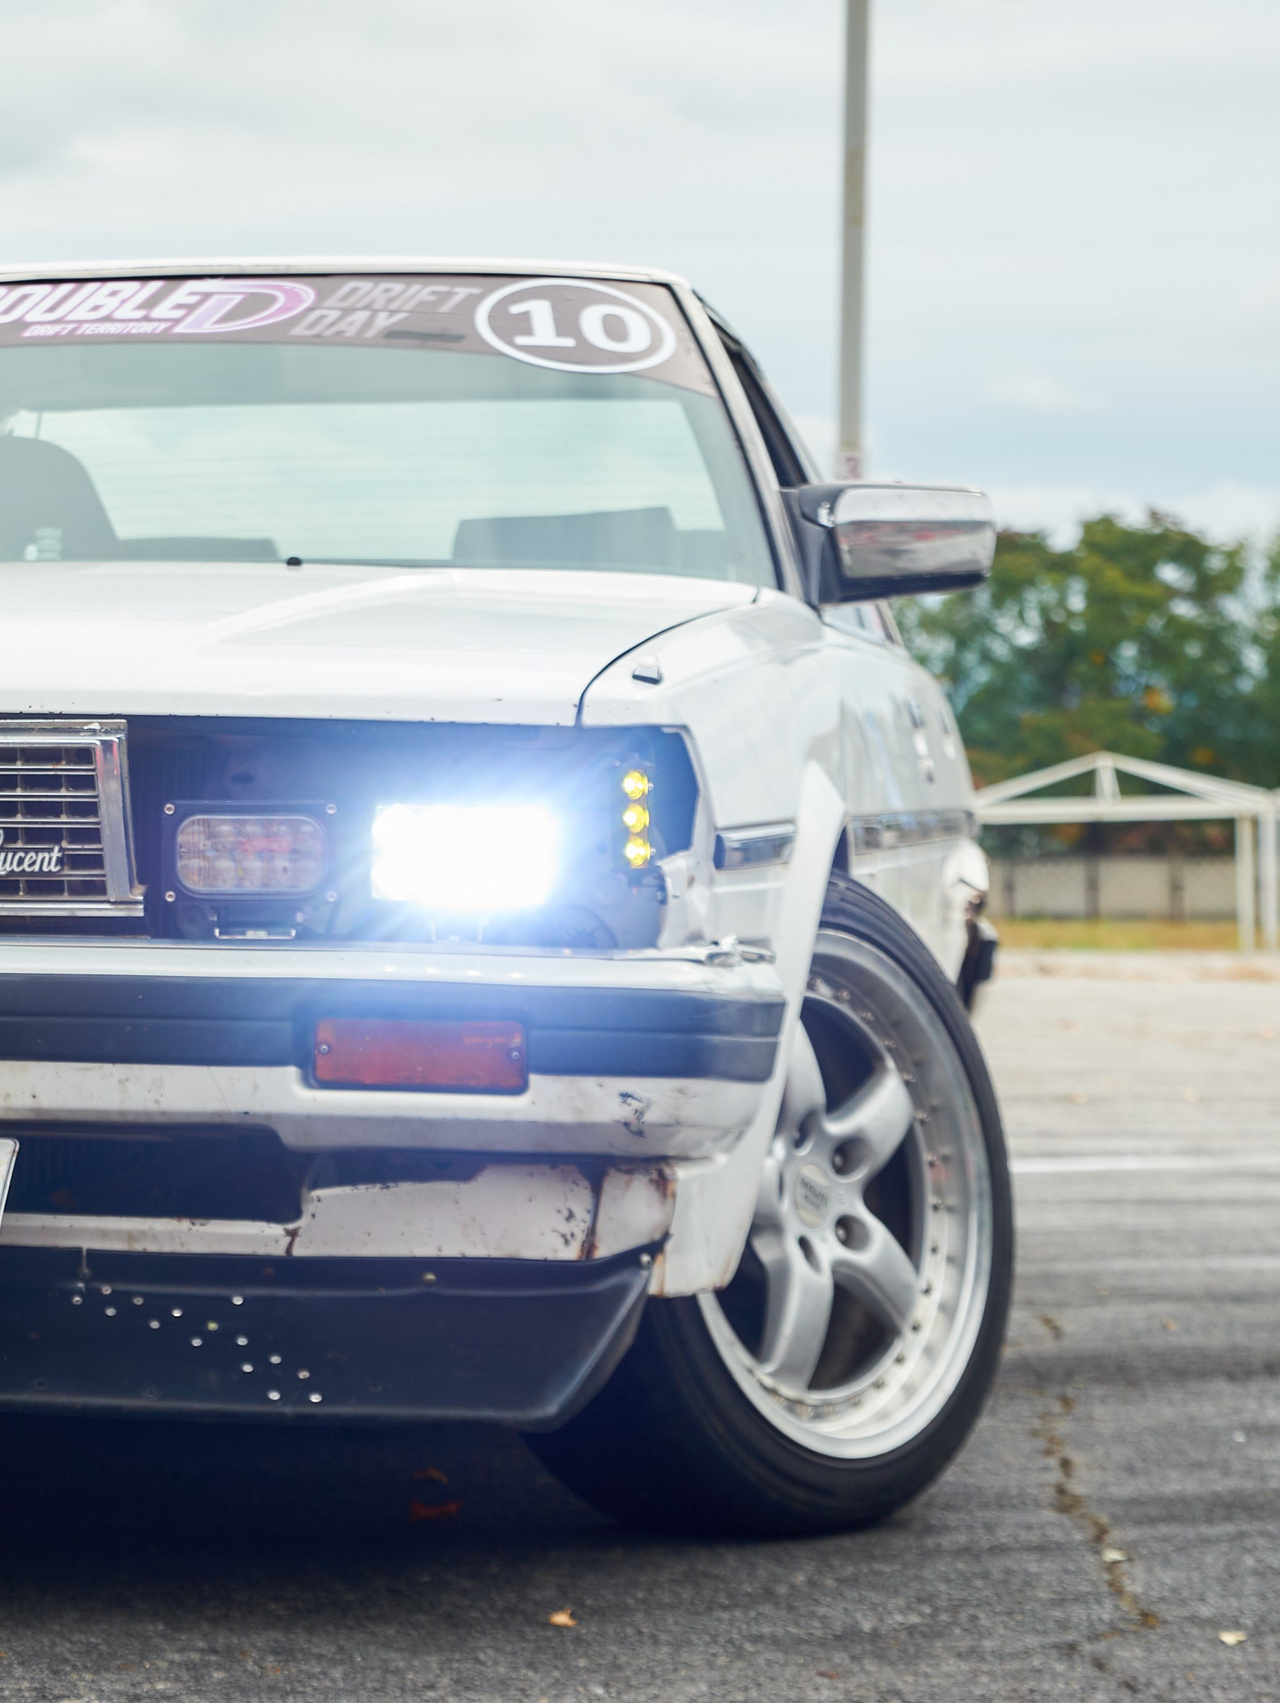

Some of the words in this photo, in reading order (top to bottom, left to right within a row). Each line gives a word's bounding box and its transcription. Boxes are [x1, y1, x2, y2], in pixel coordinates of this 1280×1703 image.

[323, 281, 483, 313] DRIFT
[21, 323, 79, 337] DRIFT
[74, 321, 174, 335] TERRITORY
[288, 309, 410, 338] DAY
[508, 298, 652, 354] 10
